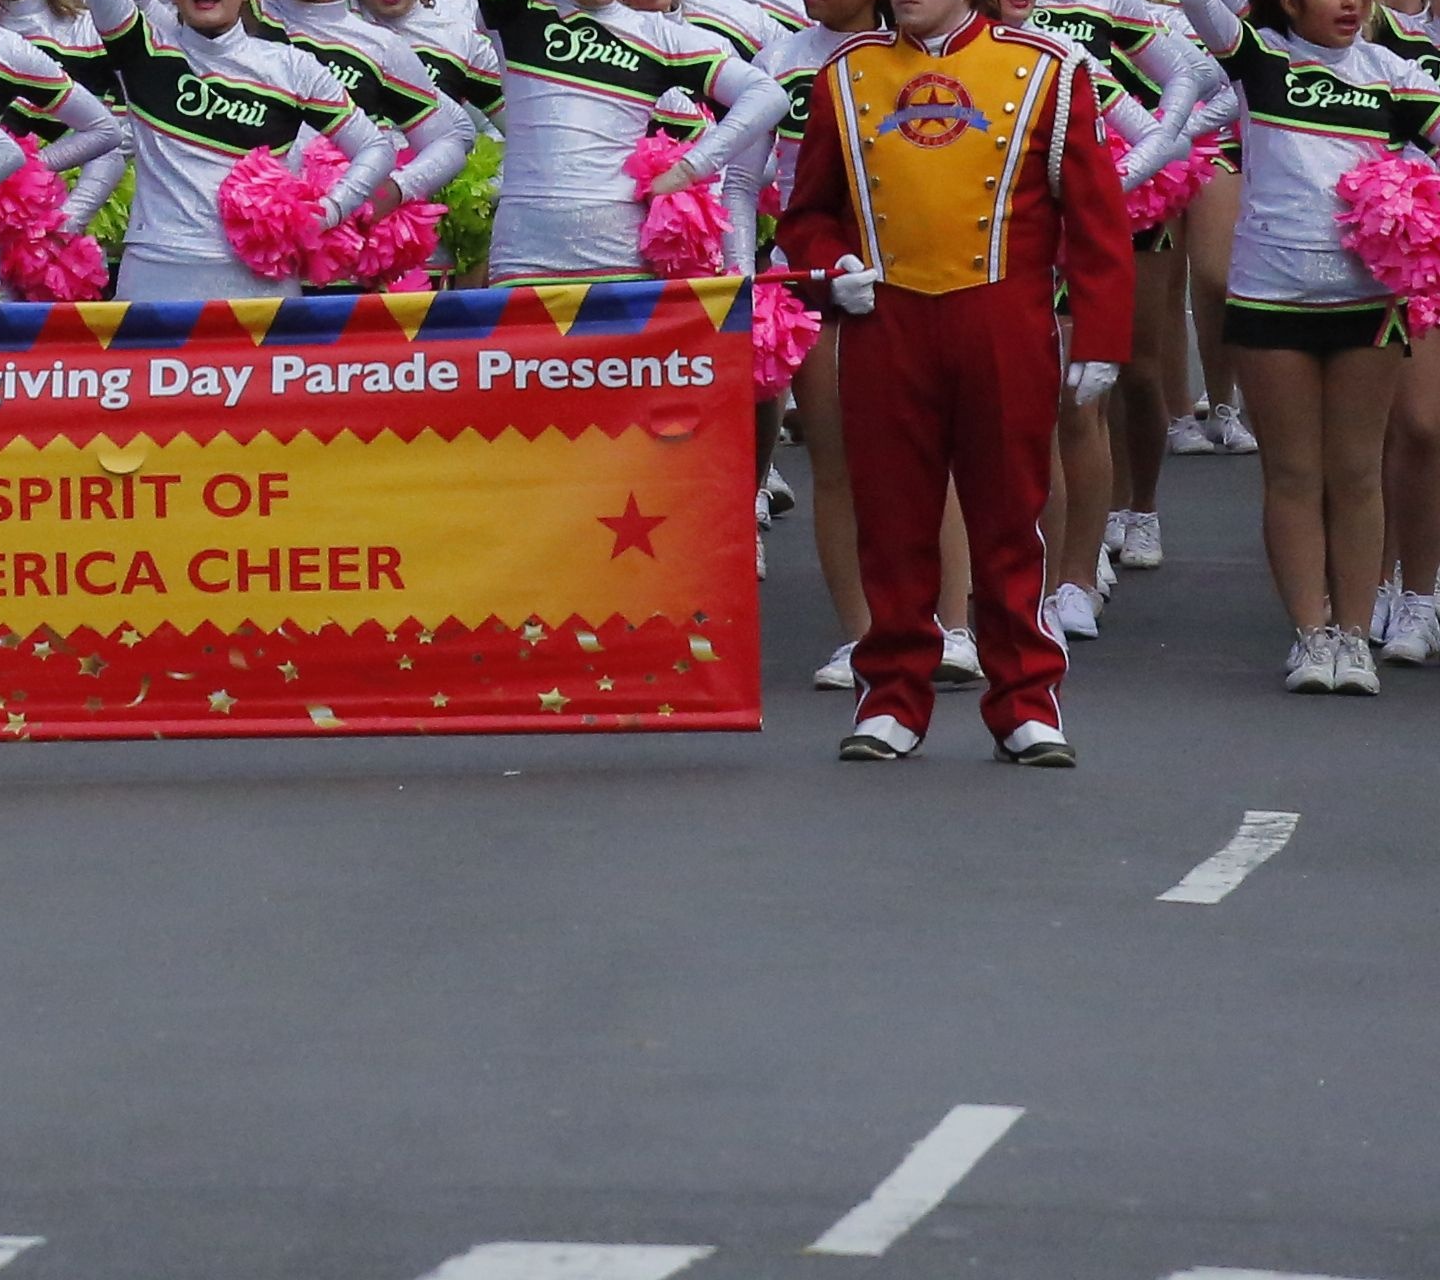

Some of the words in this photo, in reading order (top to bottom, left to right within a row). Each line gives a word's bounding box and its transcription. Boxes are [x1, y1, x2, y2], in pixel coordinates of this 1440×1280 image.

[176, 73, 269, 127] Spirit
[148, 357, 254, 407] Day
[270, 351, 459, 395] Parade
[478, 348, 715, 390] Presents
[202, 473, 290, 518] OF
[187, 546, 405, 593] CHEER
